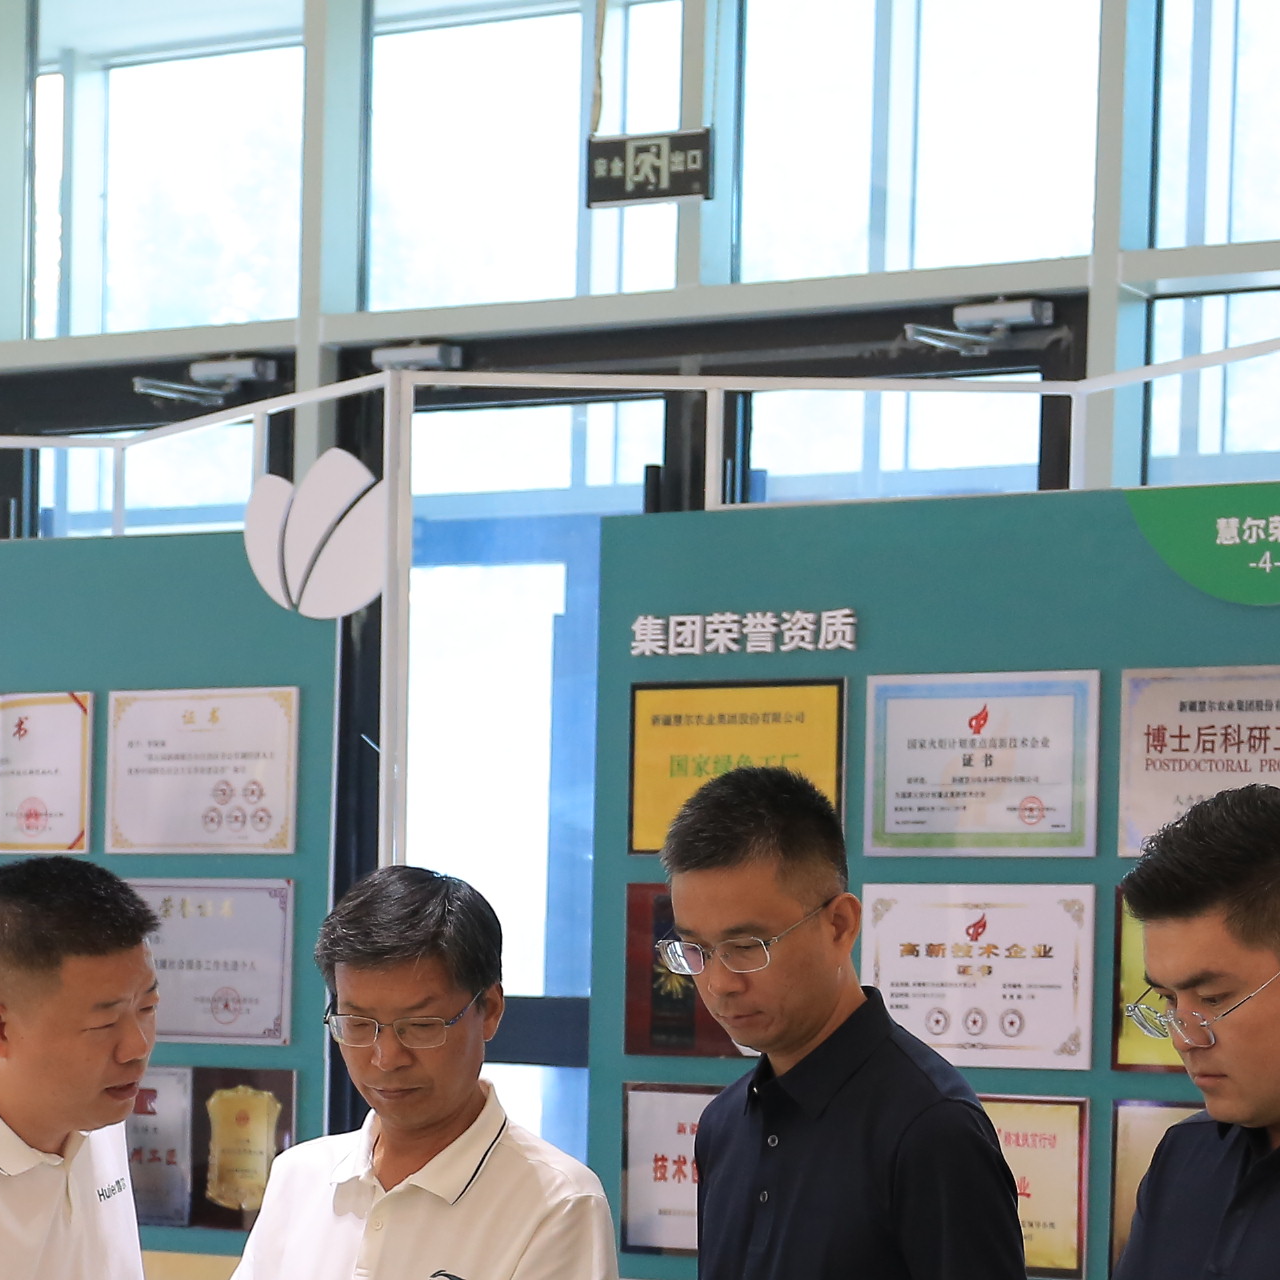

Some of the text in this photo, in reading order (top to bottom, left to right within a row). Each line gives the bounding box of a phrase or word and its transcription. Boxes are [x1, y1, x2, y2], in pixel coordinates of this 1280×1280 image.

[630, 607, 857, 657] 集团荣誉资质
[962, 753, 995, 768] 证书
[1145, 758, 1252, 773] POSTDOCTORAL
[899, 943, 1054, 959] 高新技术企业
